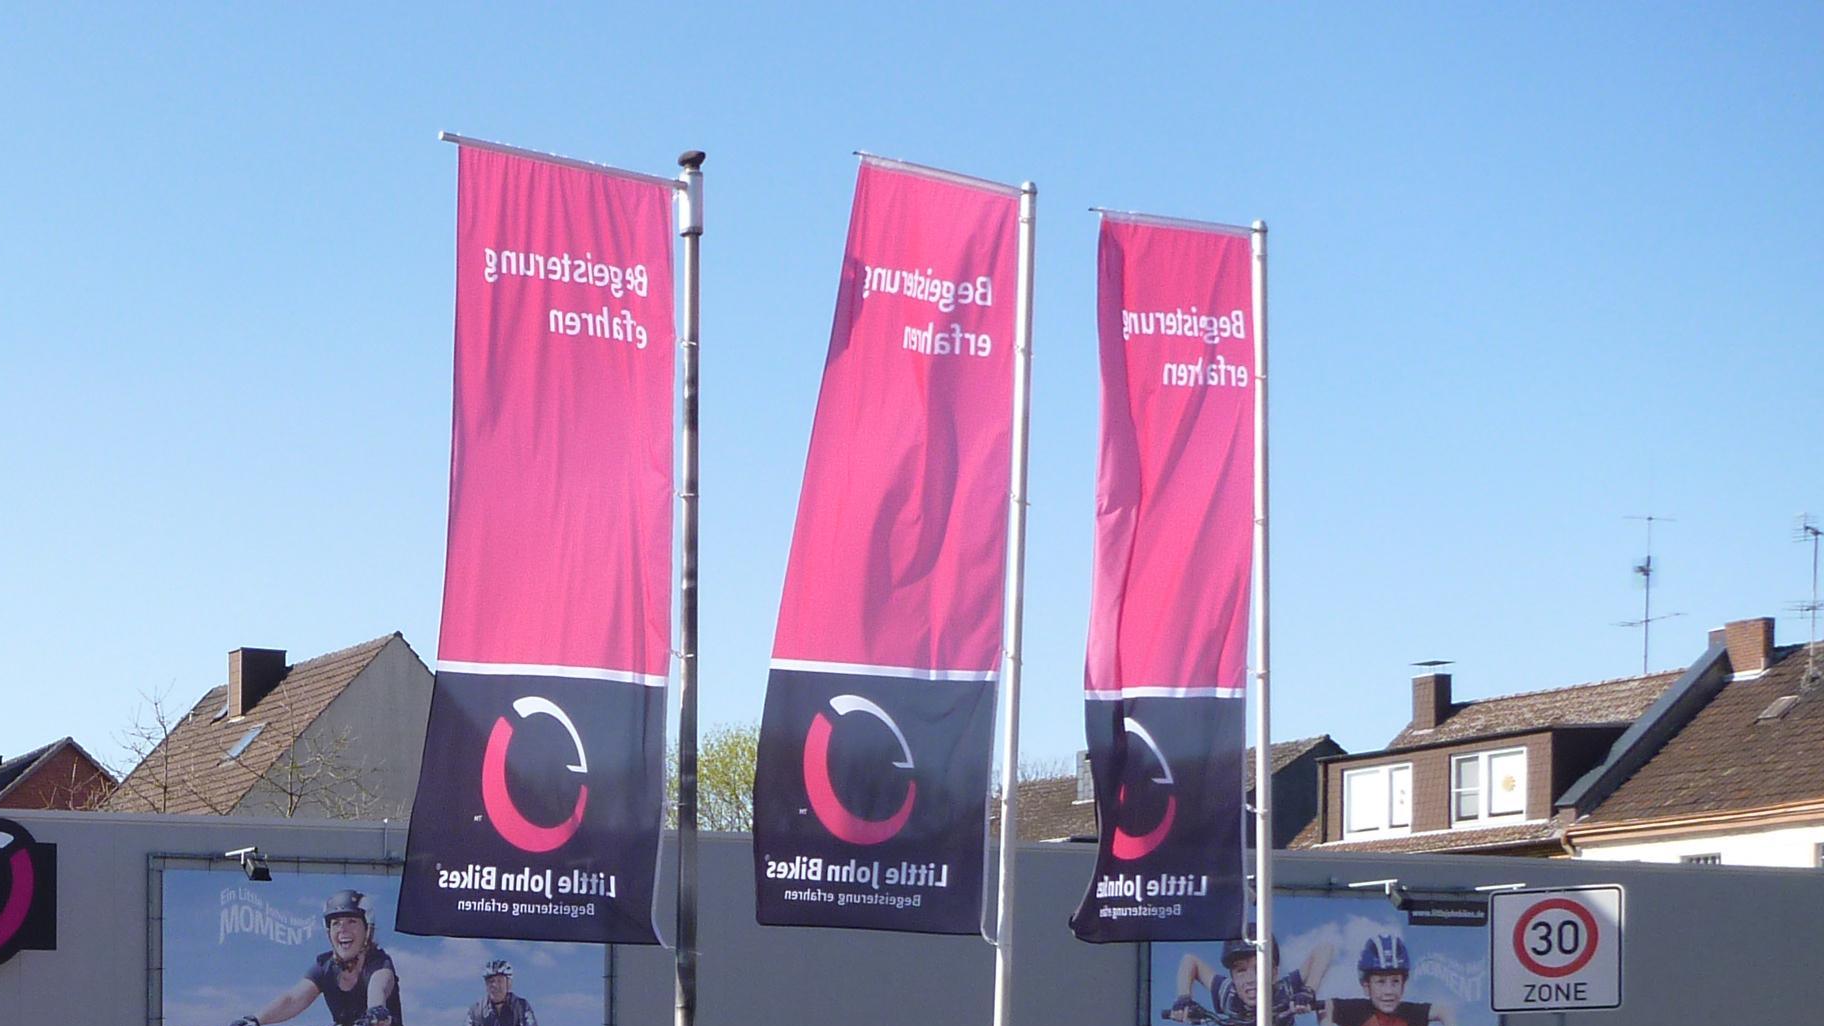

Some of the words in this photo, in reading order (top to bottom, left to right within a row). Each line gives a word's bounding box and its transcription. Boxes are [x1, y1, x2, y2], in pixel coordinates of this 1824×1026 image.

[219, 904, 313, 945] MOMENT
[1530, 919, 1580, 956] 30
[1523, 982, 1588, 1002] ZONE
